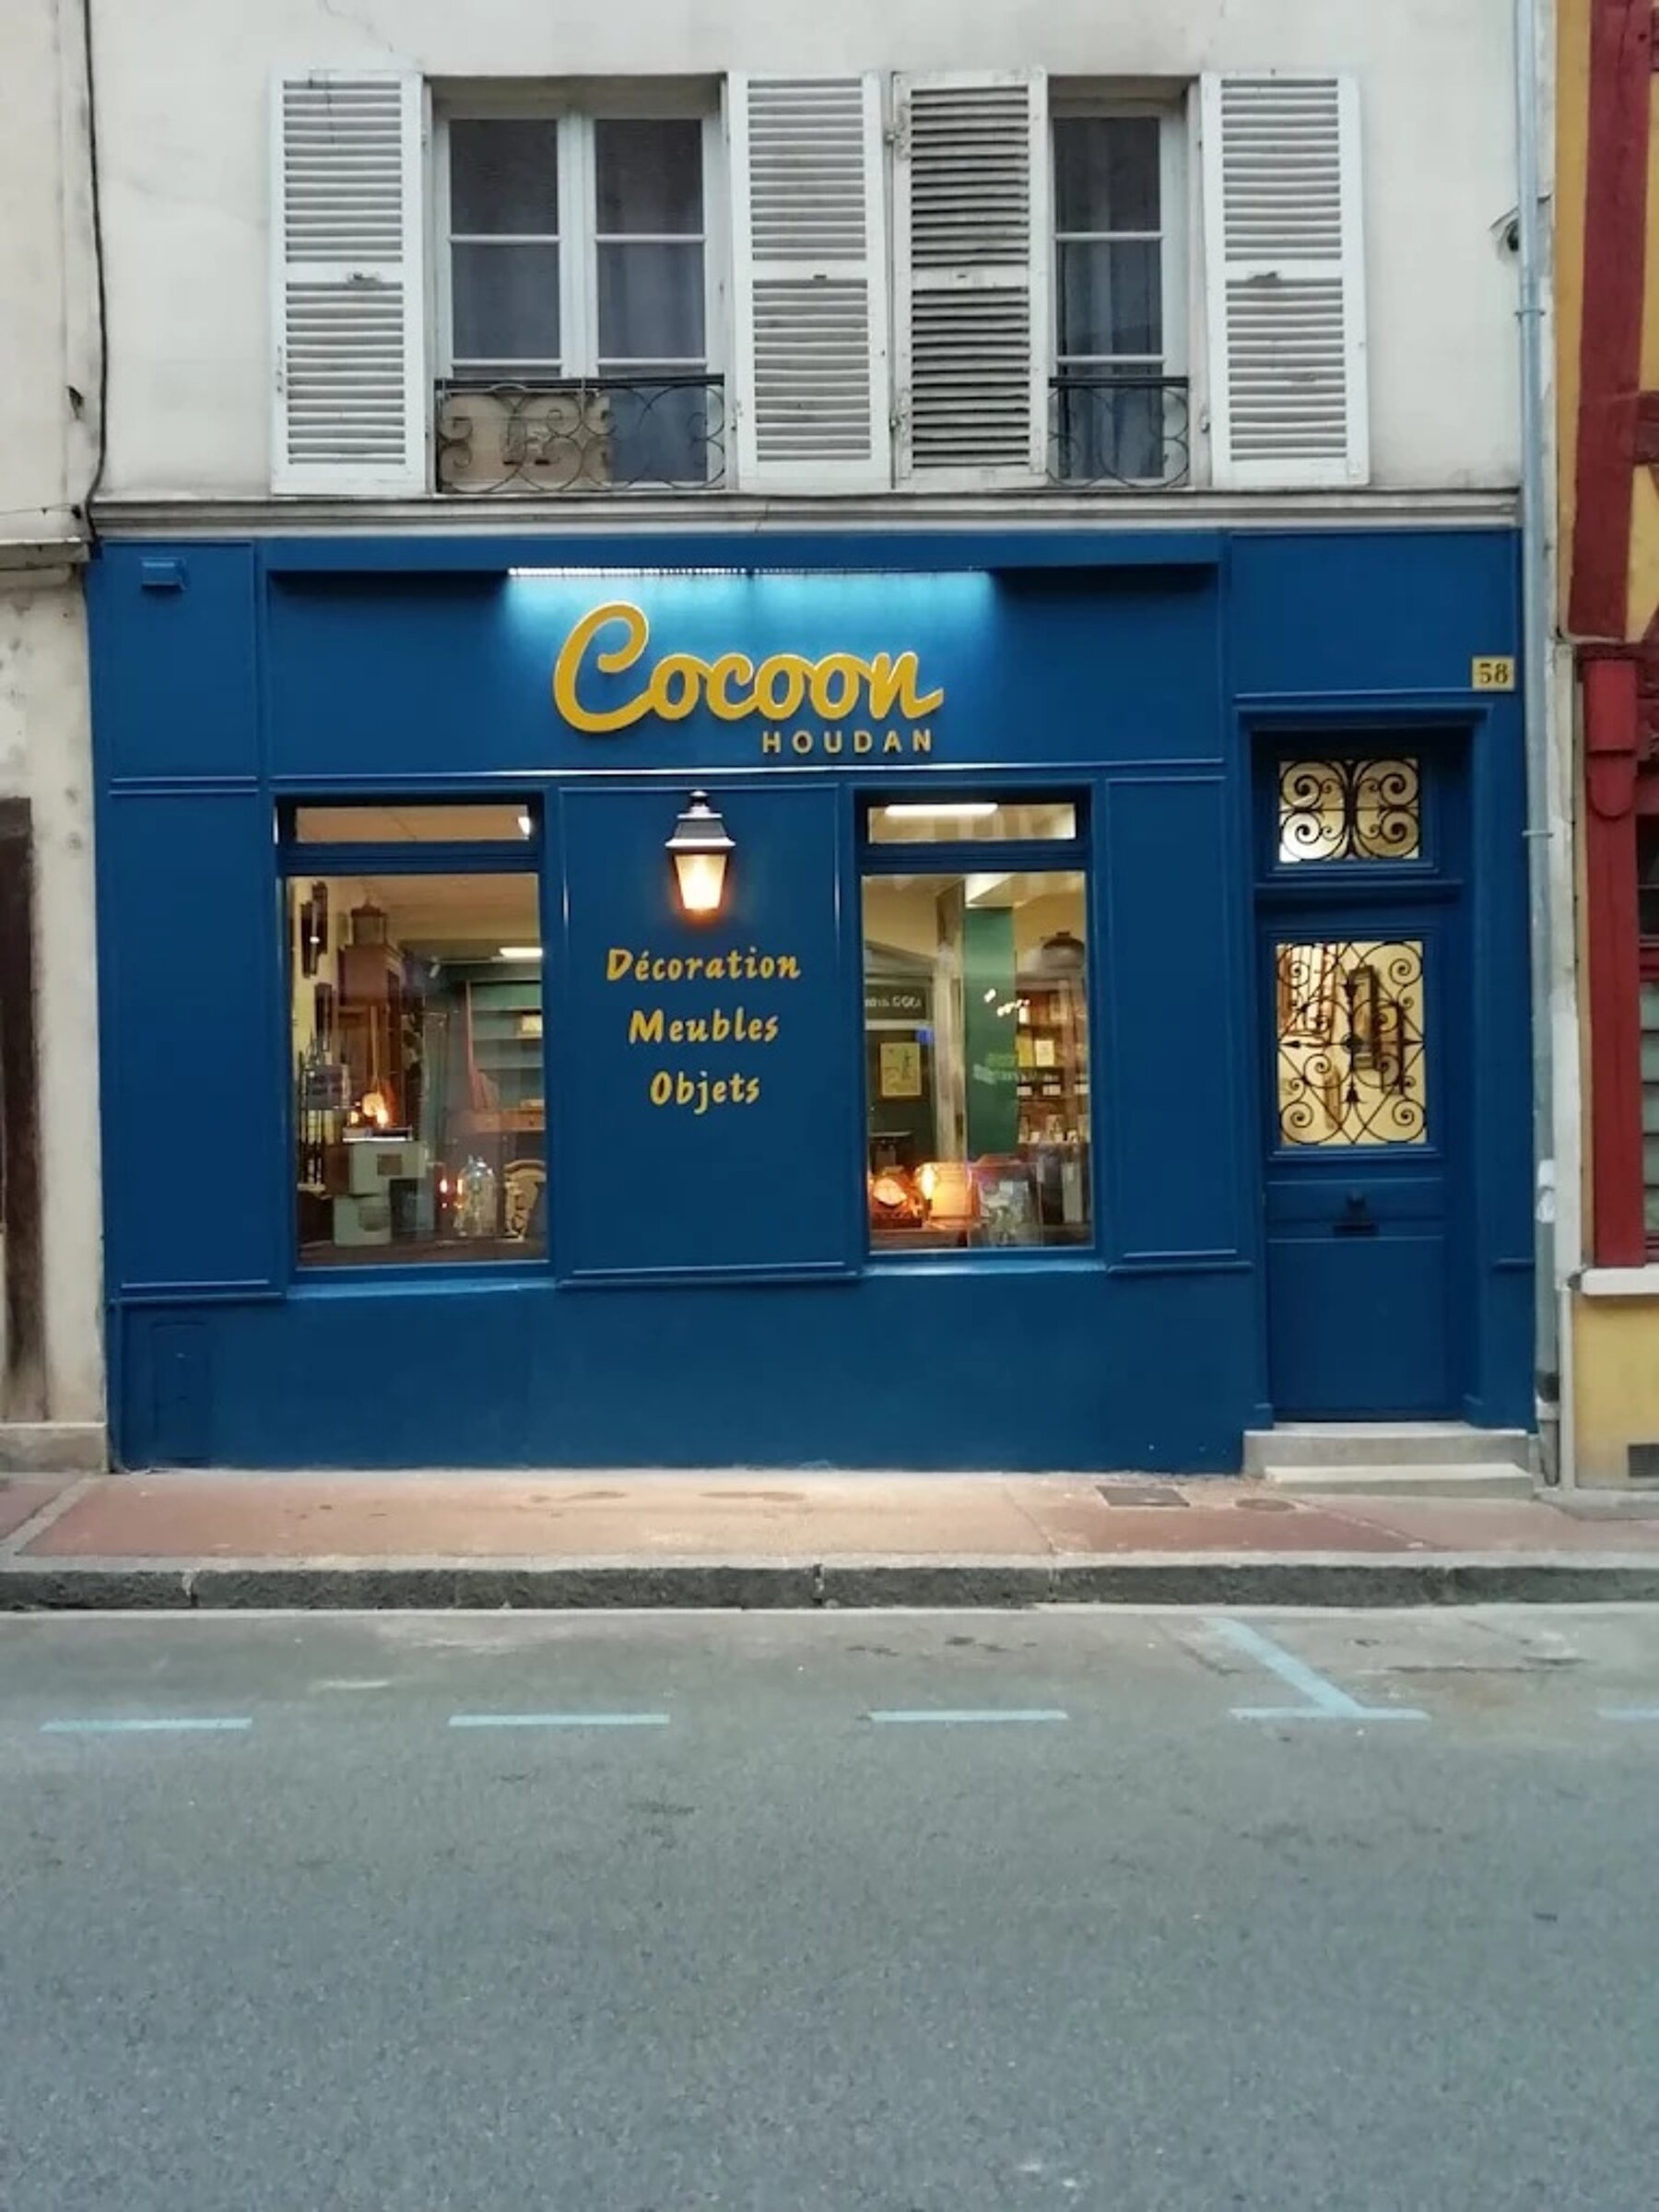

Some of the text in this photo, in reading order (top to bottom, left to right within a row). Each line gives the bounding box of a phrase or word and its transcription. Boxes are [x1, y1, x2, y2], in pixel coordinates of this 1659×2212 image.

[553, 601, 945, 733] Cocoon
[1479, 663, 1509, 684] 58
[762, 728, 932, 753] HOUDAN
[606, 946, 801, 981] Décoration
[629, 1006, 779, 1043] Meubles
[650, 1070, 759, 1114] Objets
